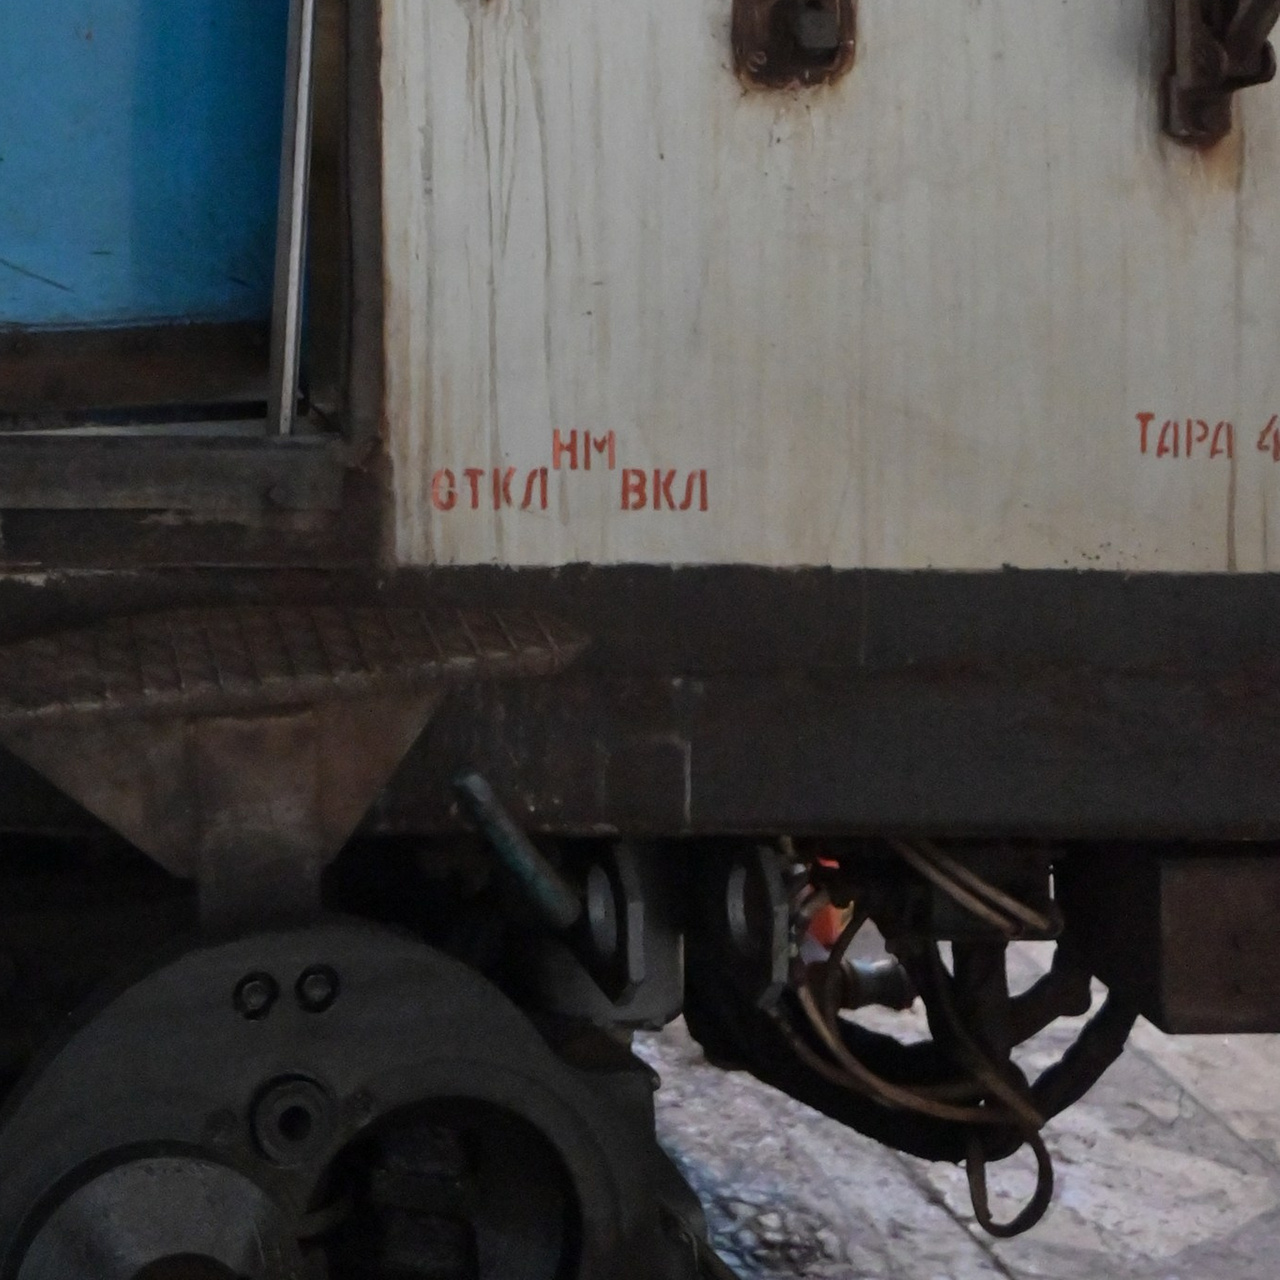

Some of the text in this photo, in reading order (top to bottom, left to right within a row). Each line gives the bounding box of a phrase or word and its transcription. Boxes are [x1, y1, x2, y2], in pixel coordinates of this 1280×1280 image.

[552, 428, 615, 471] НМ
[1135, 411, 1234, 459] ТАРА
[431, 465, 708, 512] ОТКЛ ВКЛ
